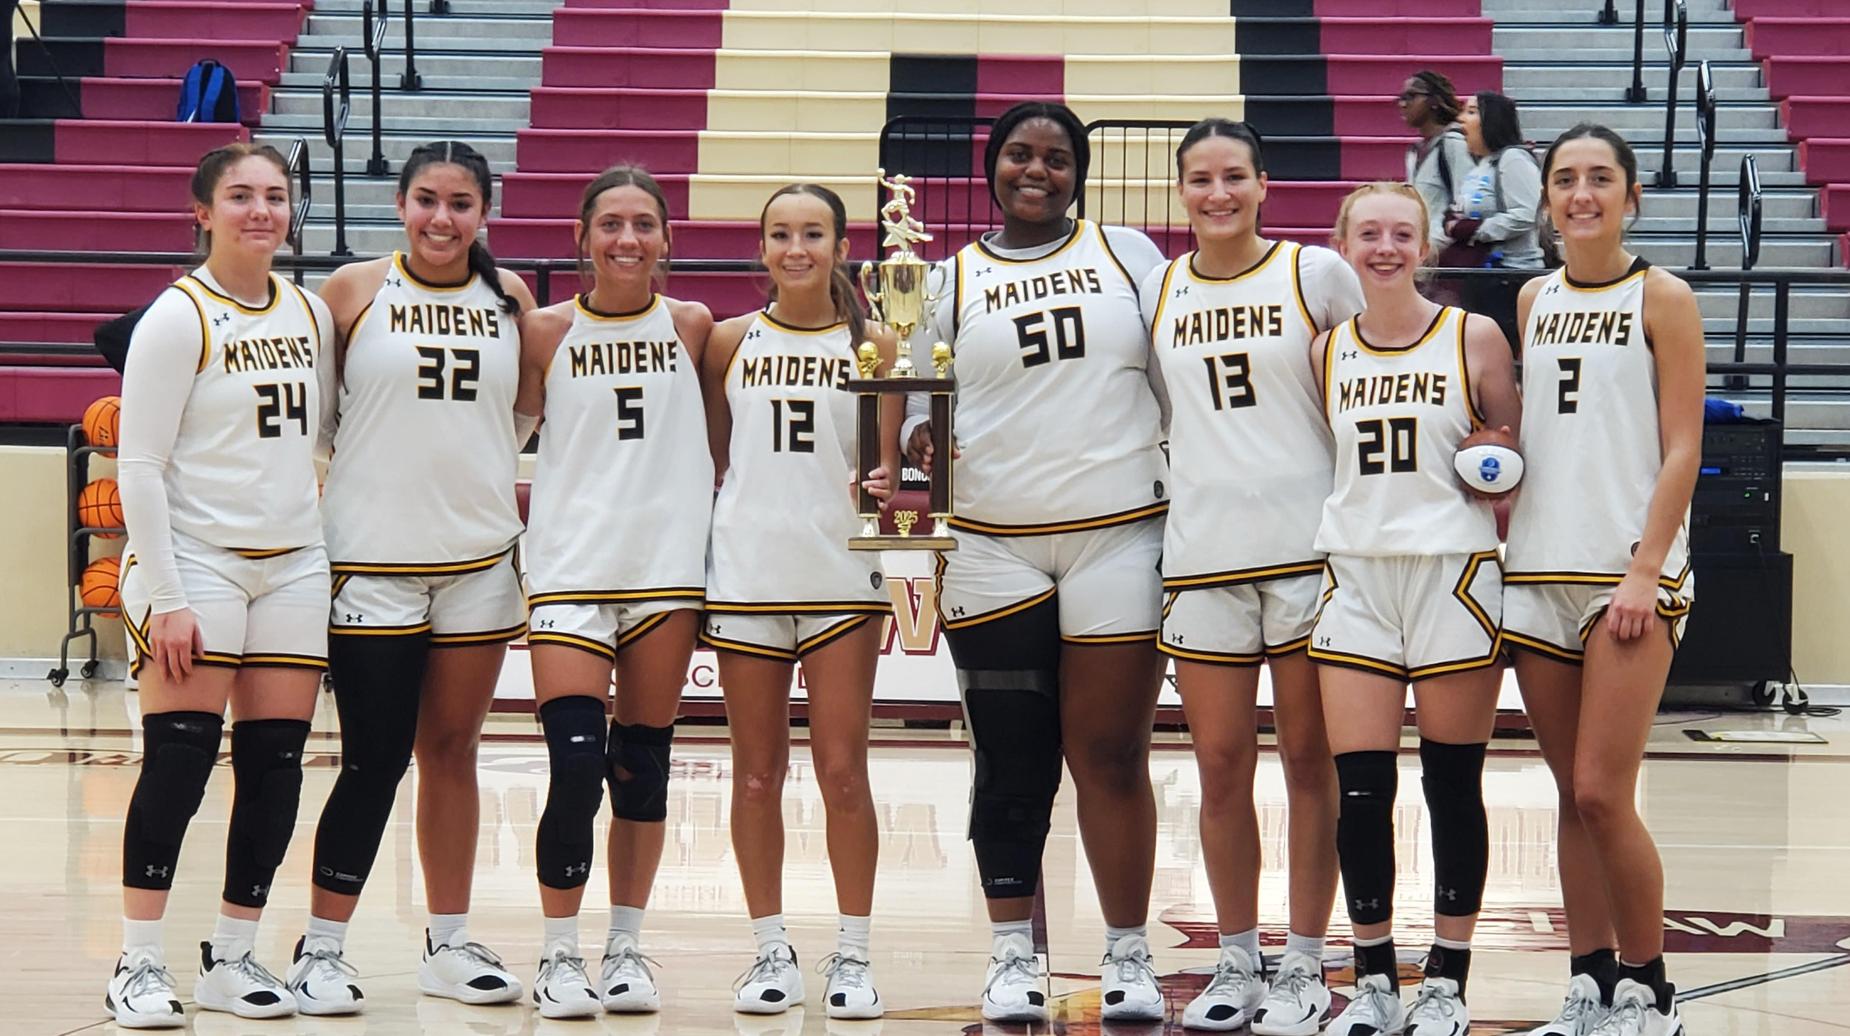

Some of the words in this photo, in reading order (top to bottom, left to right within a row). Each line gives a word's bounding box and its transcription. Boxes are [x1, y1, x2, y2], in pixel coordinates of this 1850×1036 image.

[984, 268, 1102, 314] MAIDENS
[390, 304, 500, 339] MAIDENS
[1012, 306, 1086, 369] 50
[1173, 305, 1282, 348] MAIDENS
[1532, 311, 1633, 346] MAIDENS
[224, 336, 313, 374] MAIDENS
[416, 346, 480, 402] 32
[742, 355, 851, 392] MAIDENS
[1203, 352, 1257, 411] 13
[1339, 372, 1447, 413] MAIDENS
[1557, 358, 1582, 415] 2
[253, 382, 308, 439] 24
[613, 386, 645, 441] 5
[770, 399, 815, 454] 12
[1355, 417, 1418, 476] 20
[893, 510, 919, 524] 2025
